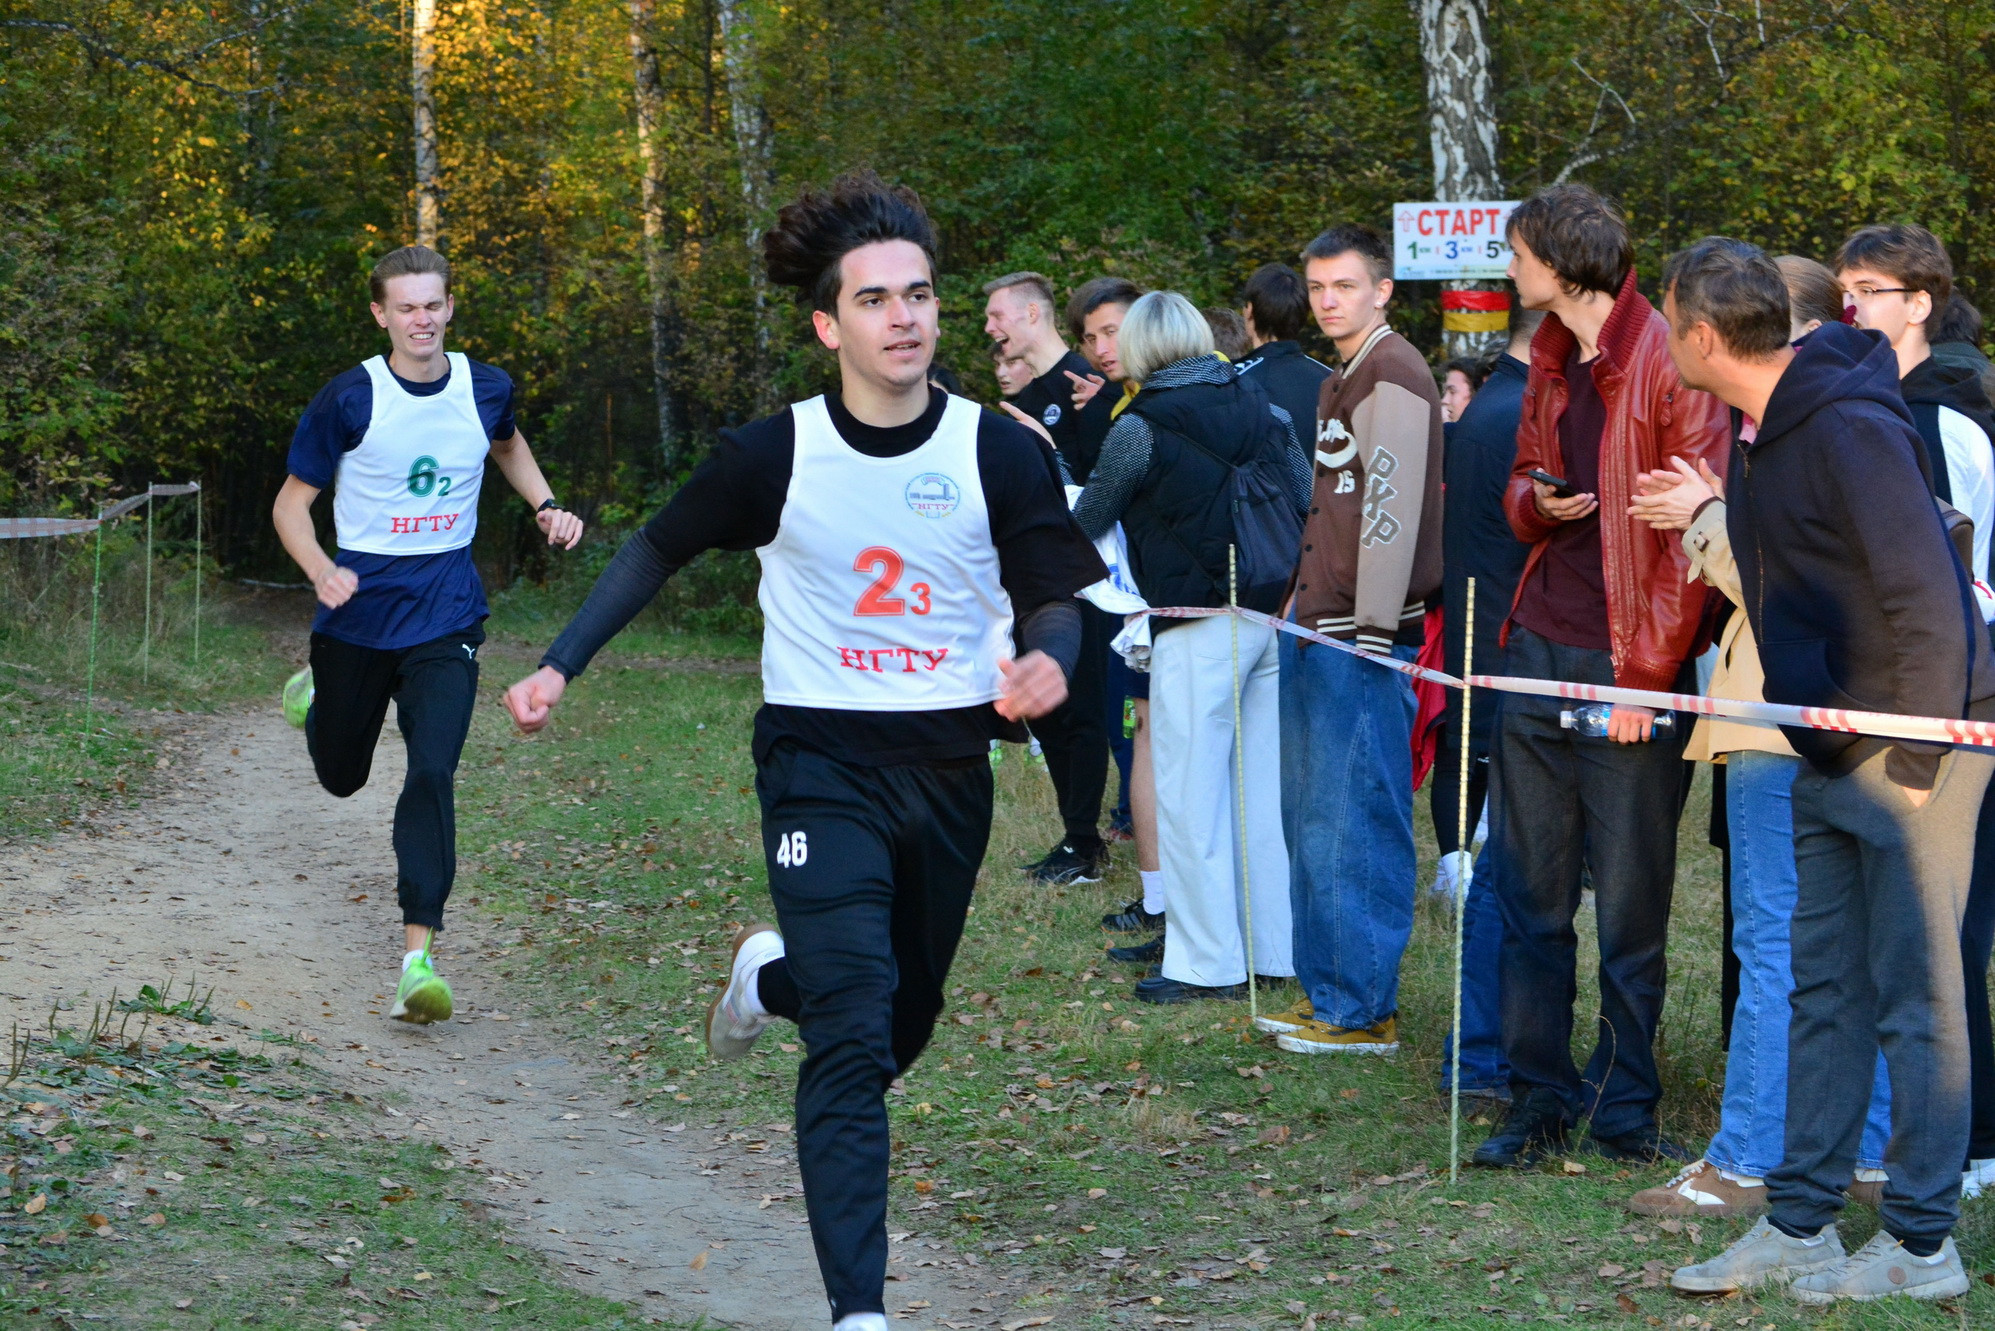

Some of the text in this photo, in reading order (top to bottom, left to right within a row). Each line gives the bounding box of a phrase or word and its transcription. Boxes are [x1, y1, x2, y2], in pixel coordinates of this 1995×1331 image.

[1418, 209, 1500, 236] СТАРТ
[918, 503, 949, 511] НГТУ
[391, 513, 459, 533] НГТУ
[837, 646, 948, 673] НГТУ
[776, 831, 808, 869] 46
